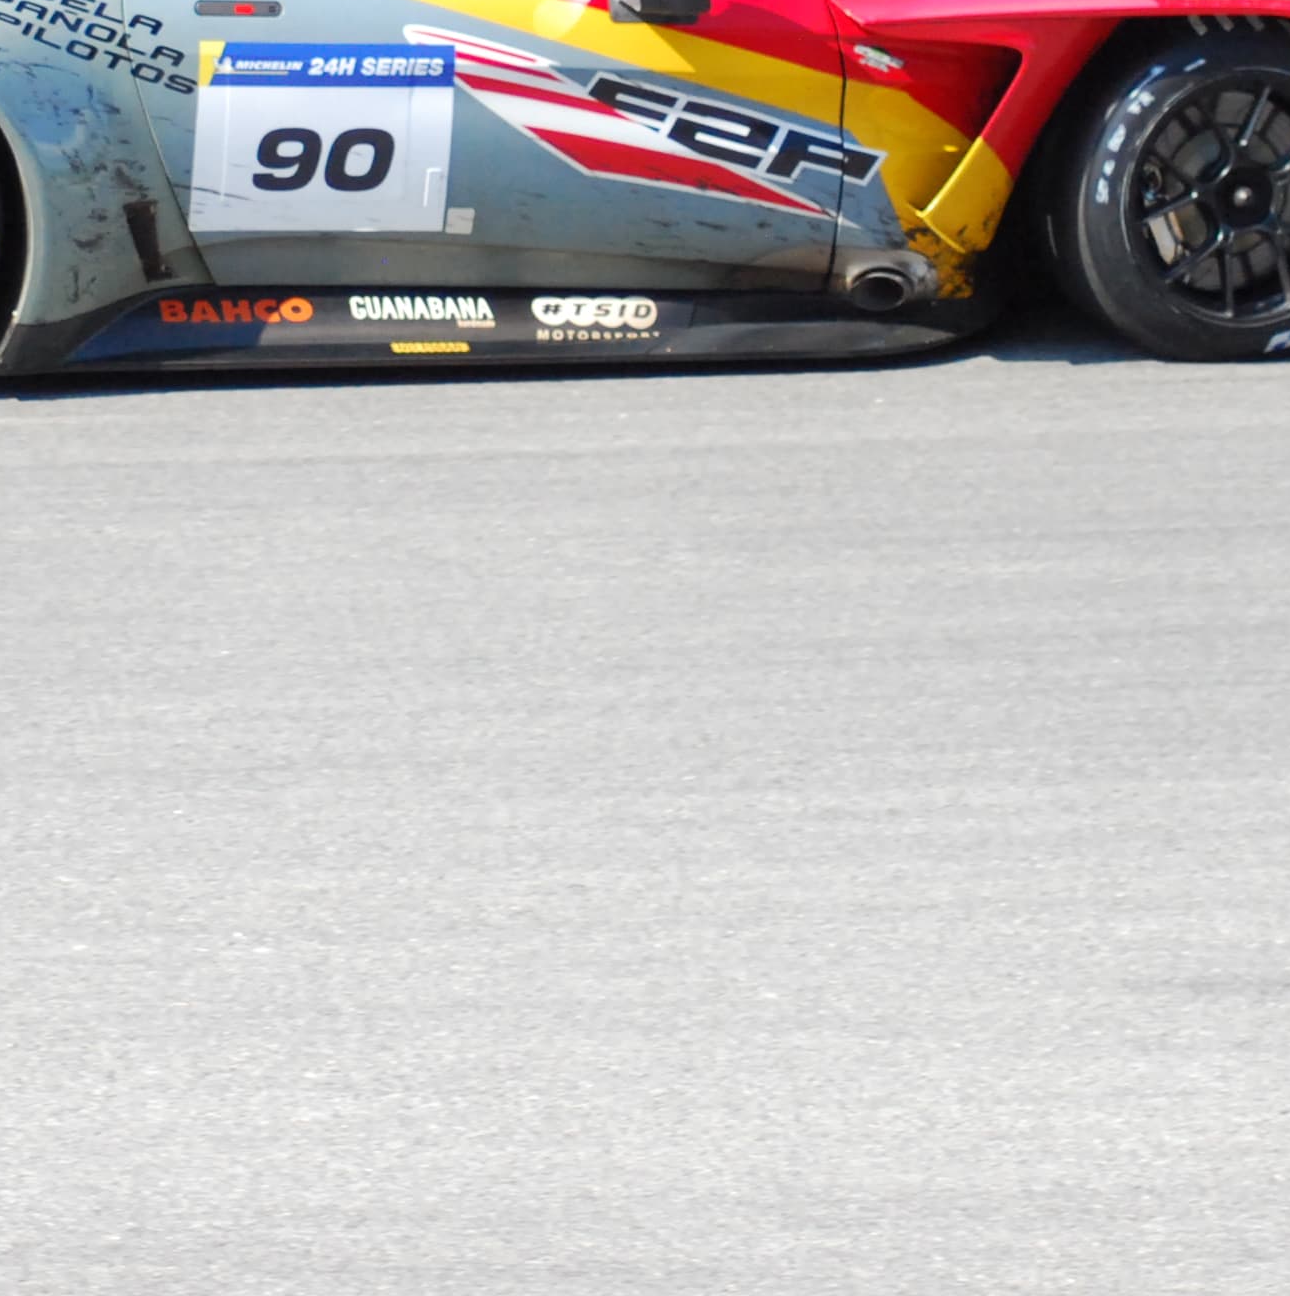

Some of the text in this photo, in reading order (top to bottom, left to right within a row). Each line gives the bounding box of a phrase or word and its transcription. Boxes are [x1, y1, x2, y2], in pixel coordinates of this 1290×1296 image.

[235, 57, 445, 76] MICHELIN 24H SERIES
[252, 127, 396, 192] 90
[160, 296, 314, 324] BAHCO
[349, 295, 495, 321] GUANABANA
